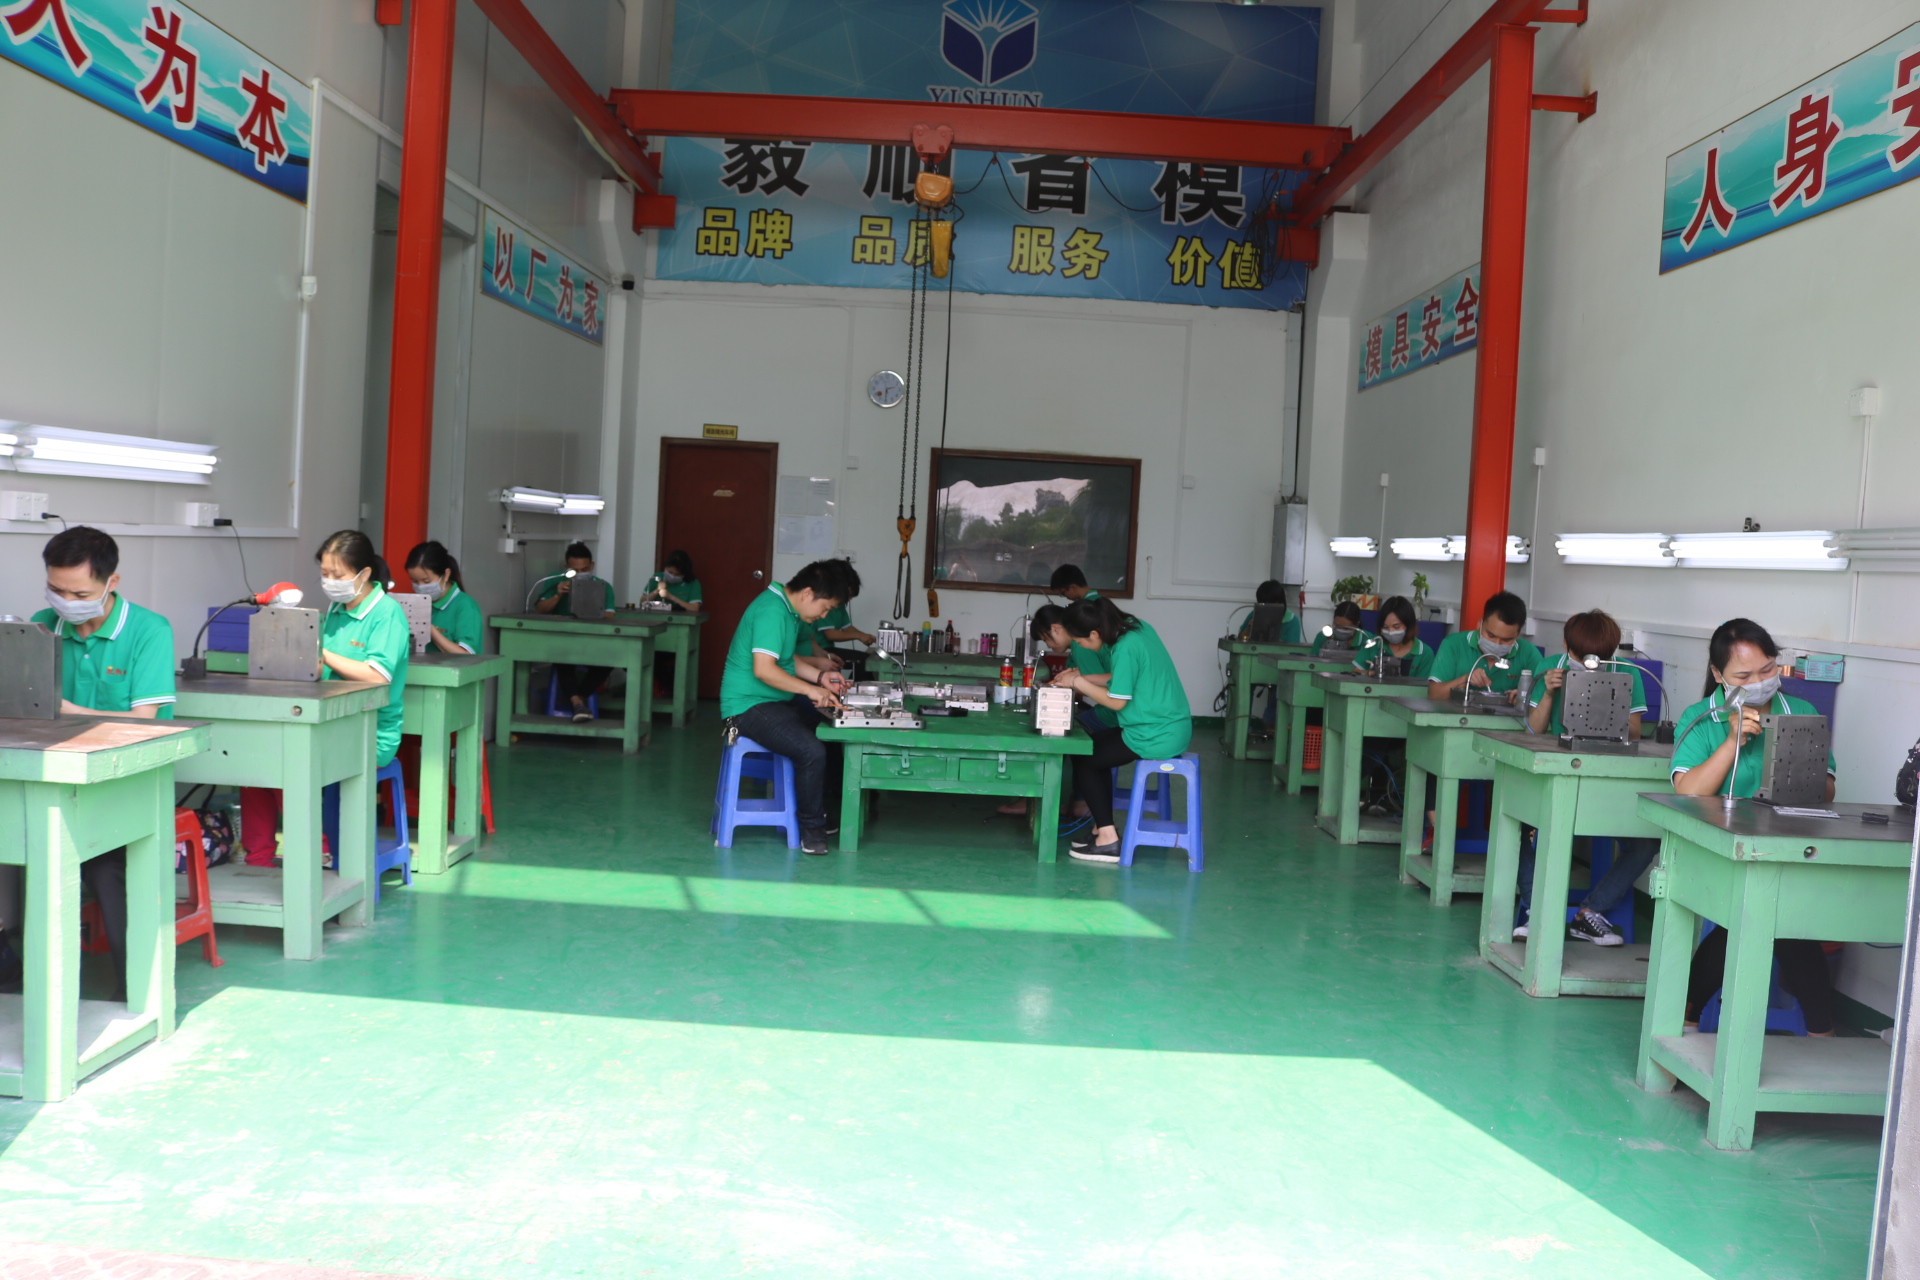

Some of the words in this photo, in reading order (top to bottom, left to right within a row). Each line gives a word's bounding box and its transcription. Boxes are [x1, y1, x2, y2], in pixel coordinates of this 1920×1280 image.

[928, 86, 1041, 108] YISHUN
[494, 226, 599, 334] 以厂为家
[695, 207, 794, 259] 品牌
[1007, 224, 1110, 280] 服务
[1166, 235, 1265, 291] 价值
[1365, 277, 1480, 382] 模具安全
